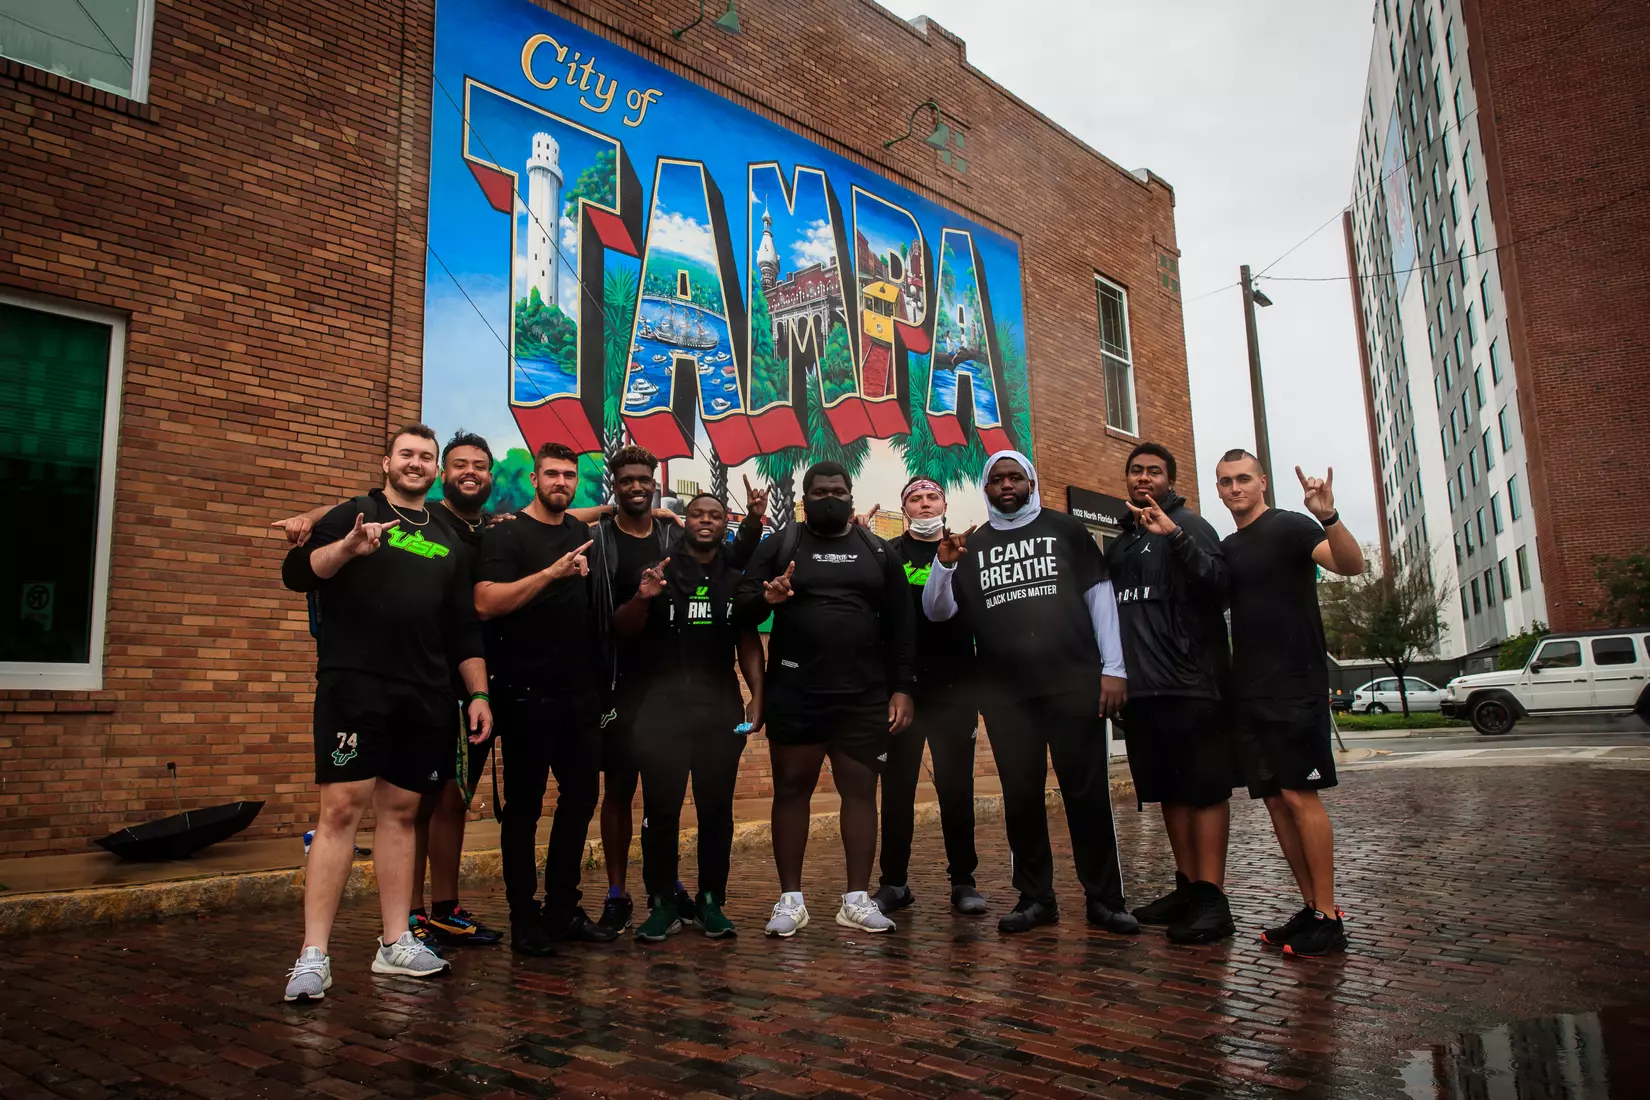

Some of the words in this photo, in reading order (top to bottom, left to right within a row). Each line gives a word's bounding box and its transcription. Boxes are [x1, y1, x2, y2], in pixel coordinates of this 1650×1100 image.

[521, 33, 618, 114] City
[623, 88, 664, 128] of
[462, 75, 1006, 432] TAMPA
[1072, 508, 1083, 518] 1102
[1083, 510, 1097, 520] North
[1097, 513, 1112, 524] Florida
[387, 525, 450, 559] USF
[977, 550, 985, 569] I
[989, 536, 1057, 564] CAN'T
[980, 556, 1058, 591] BREATHE
[985, 593, 1006, 609] BLACK
[1006, 589, 1027, 602] LIVES
[1027, 584, 1057, 597] MATTER
[336, 732, 358, 749] 74
